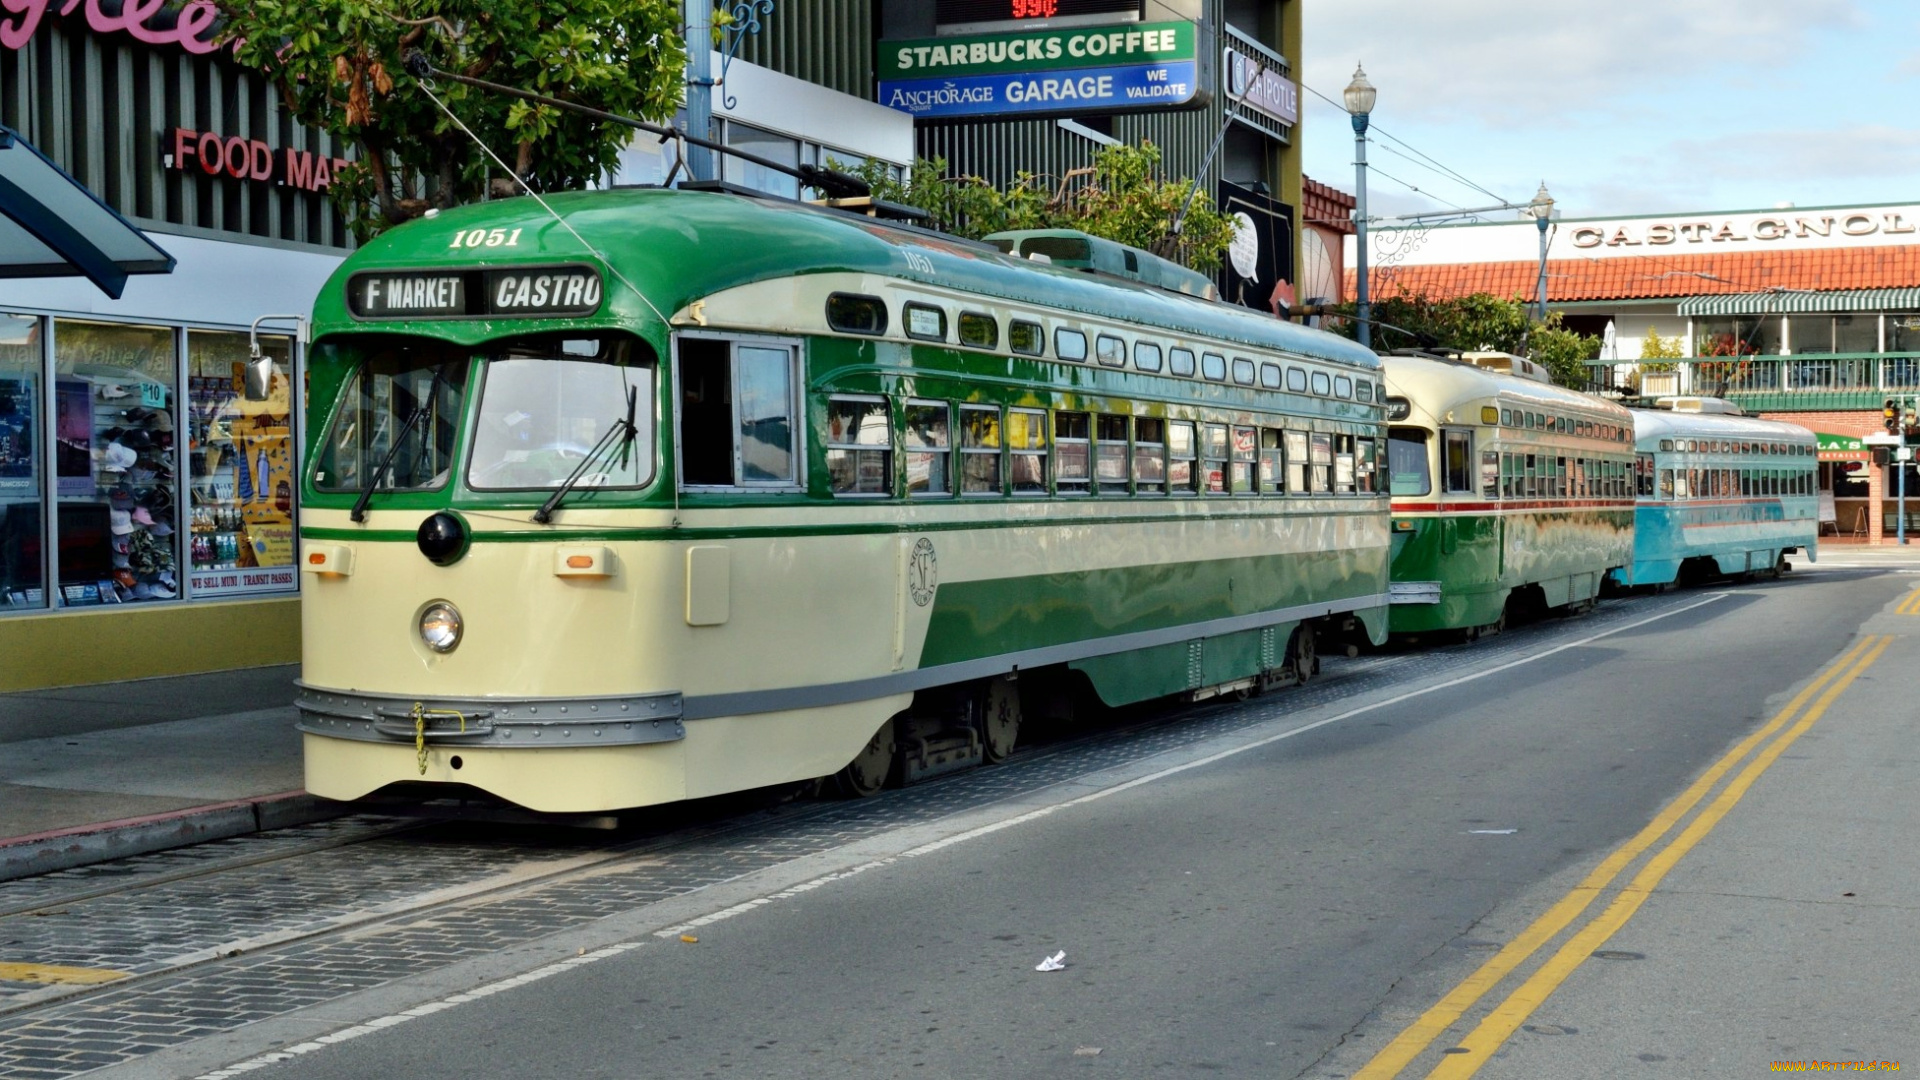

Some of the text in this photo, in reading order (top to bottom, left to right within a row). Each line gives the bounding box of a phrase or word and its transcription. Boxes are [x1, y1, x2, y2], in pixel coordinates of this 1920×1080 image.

[898, 29, 1176, 69] STARBUCKS COFFEE
[1147, 69, 1167, 81] WE
[889, 86, 993, 107] ANCHORAGE
[1006, 76, 1113, 102] GARAGE
[1126, 84, 1186, 98] VALIDATE
[1248, 68, 1297, 114] CHIPOTLE
[909, 103, 932, 112] Square
[176, 128, 355, 192] FOOD MAR
[449, 228, 523, 248] 1051
[1570, 213, 1920, 248] CASTAGNOL
[902, 250, 936, 275] 1051
[366, 277, 460, 309] F MARKET
[496, 274, 600, 307] CASTRO
[0, 480, 30, 488] RANCISCO
[191, 577, 202, 589] WE
[204, 576, 219, 588] SELL
[221, 575, 238, 587] MUNI
[243, 573, 270, 586] TRANSIT
[270, 572, 292, 585] PASSES
[917, 553, 928, 591] SF
